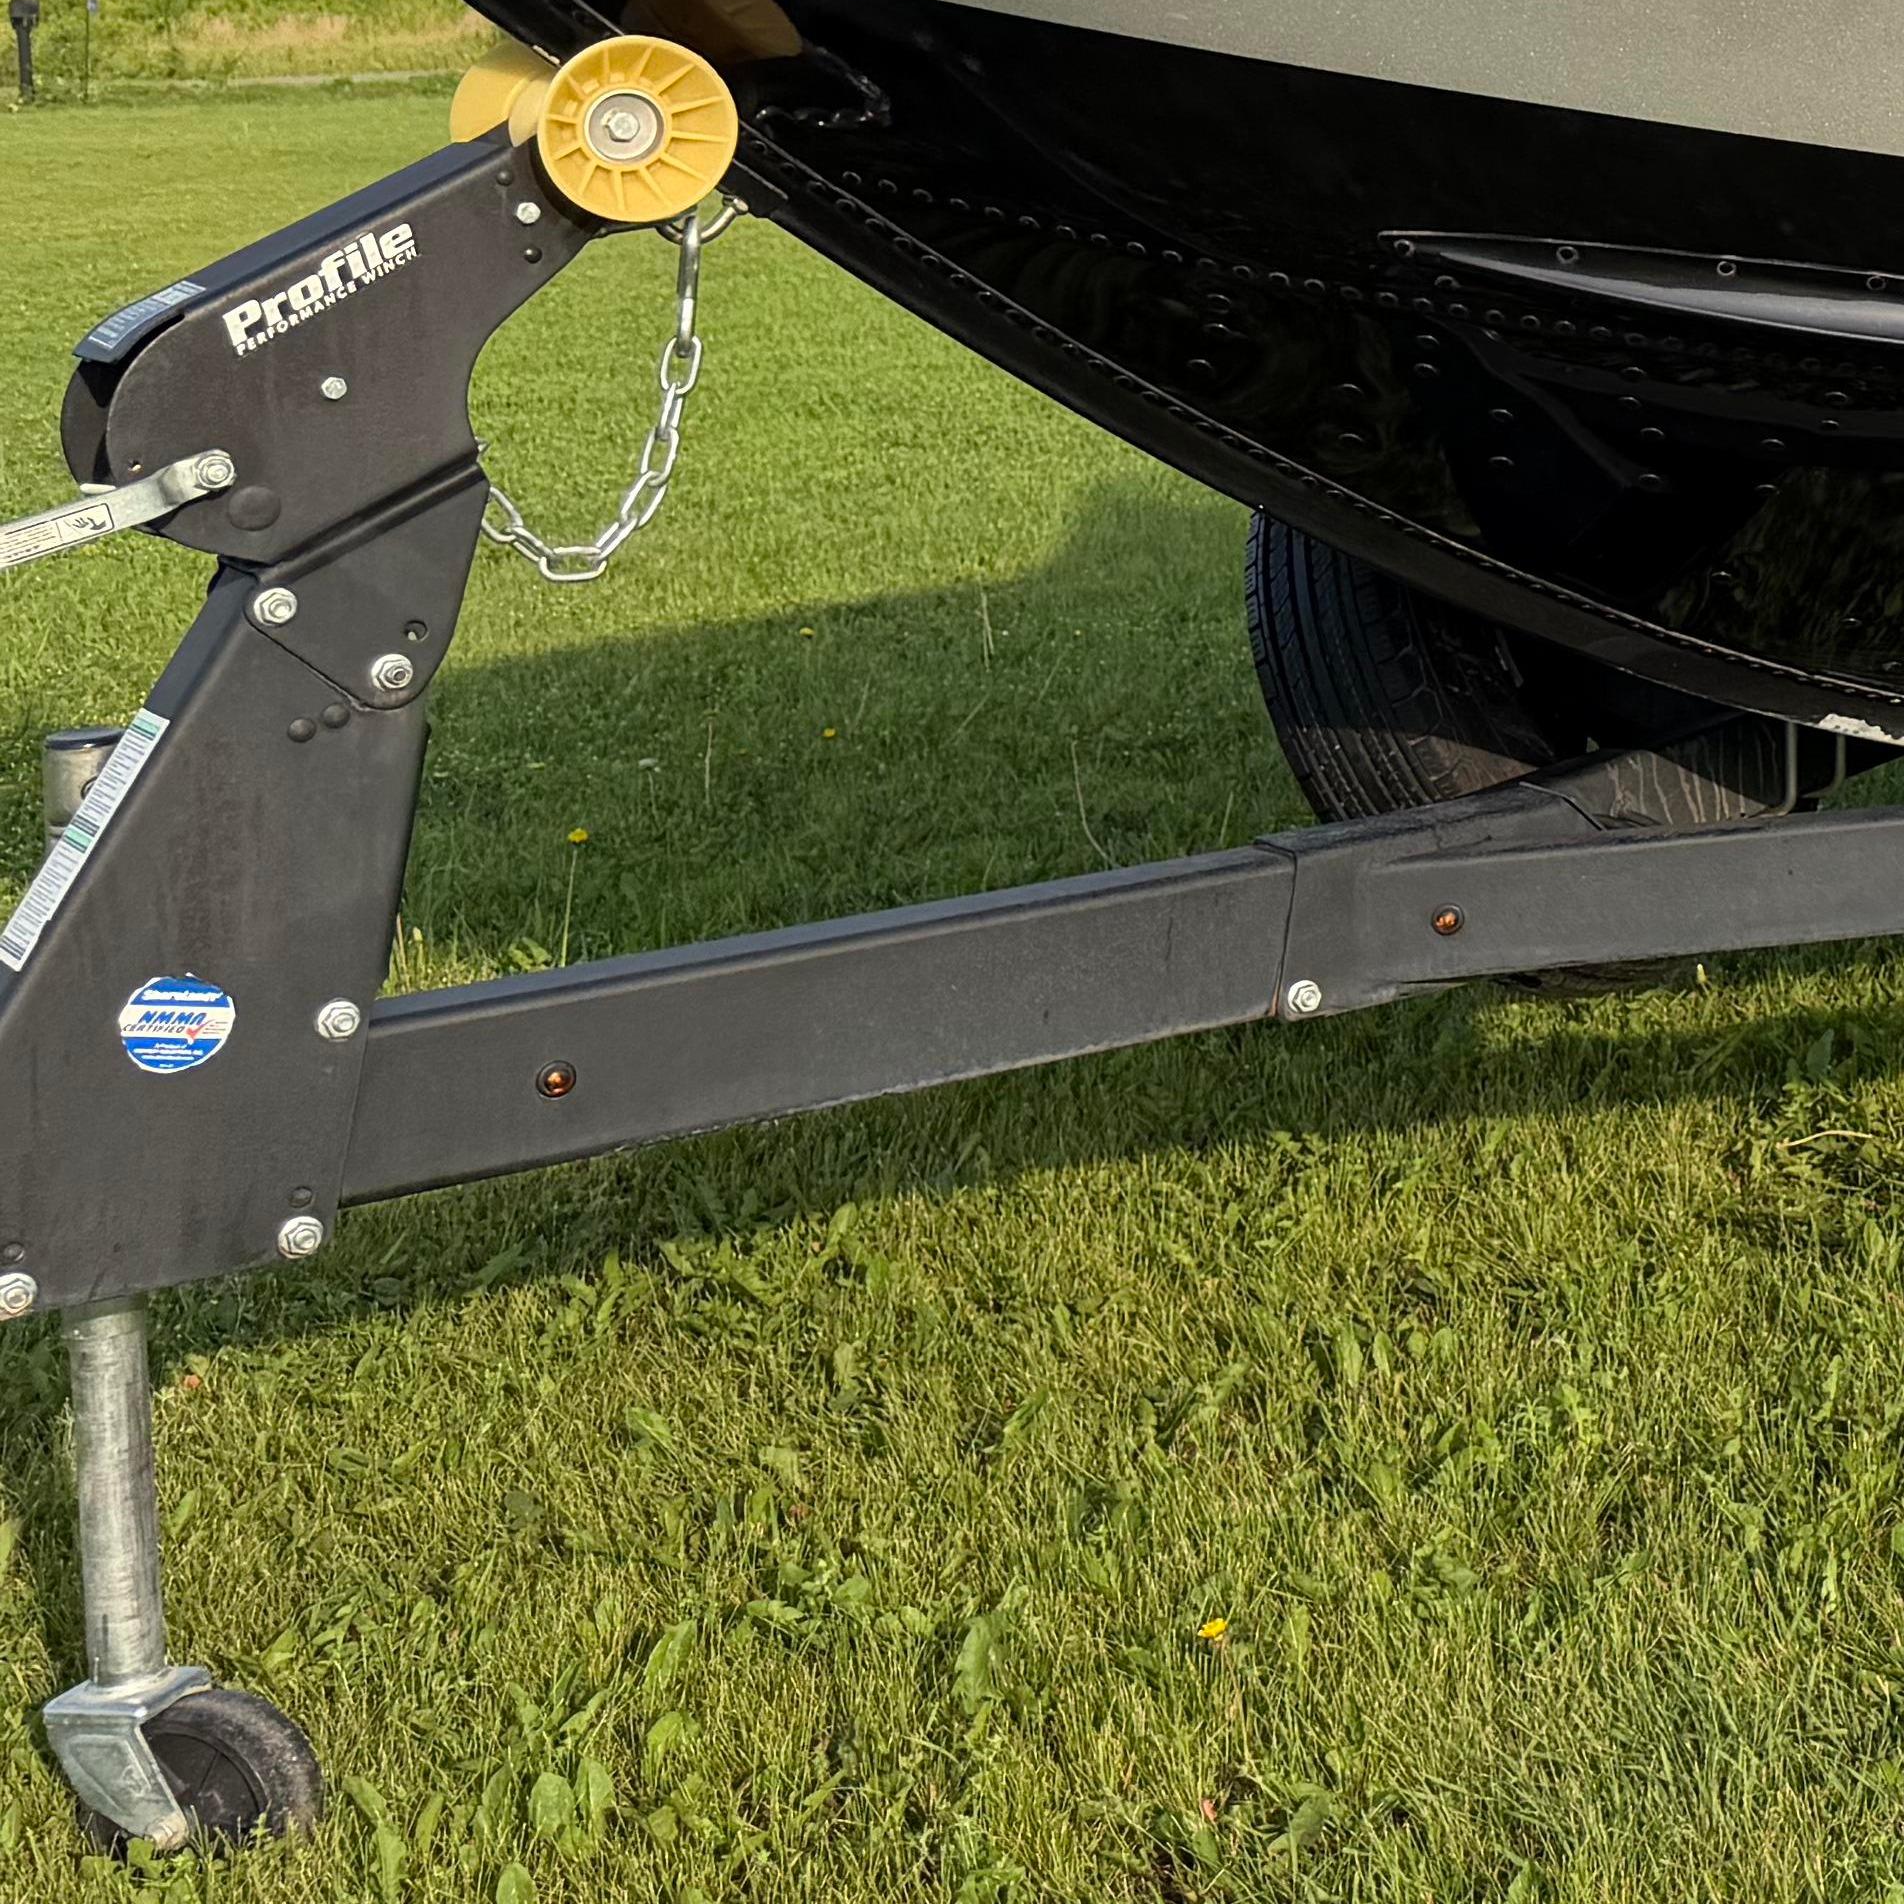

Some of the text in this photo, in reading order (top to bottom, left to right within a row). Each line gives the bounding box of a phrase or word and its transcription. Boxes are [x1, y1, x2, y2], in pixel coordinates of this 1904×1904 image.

[222, 223, 415, 347] Profile
[235, 280, 357, 356] PERFORMANCE
[362, 246, 418, 286] WINCH
